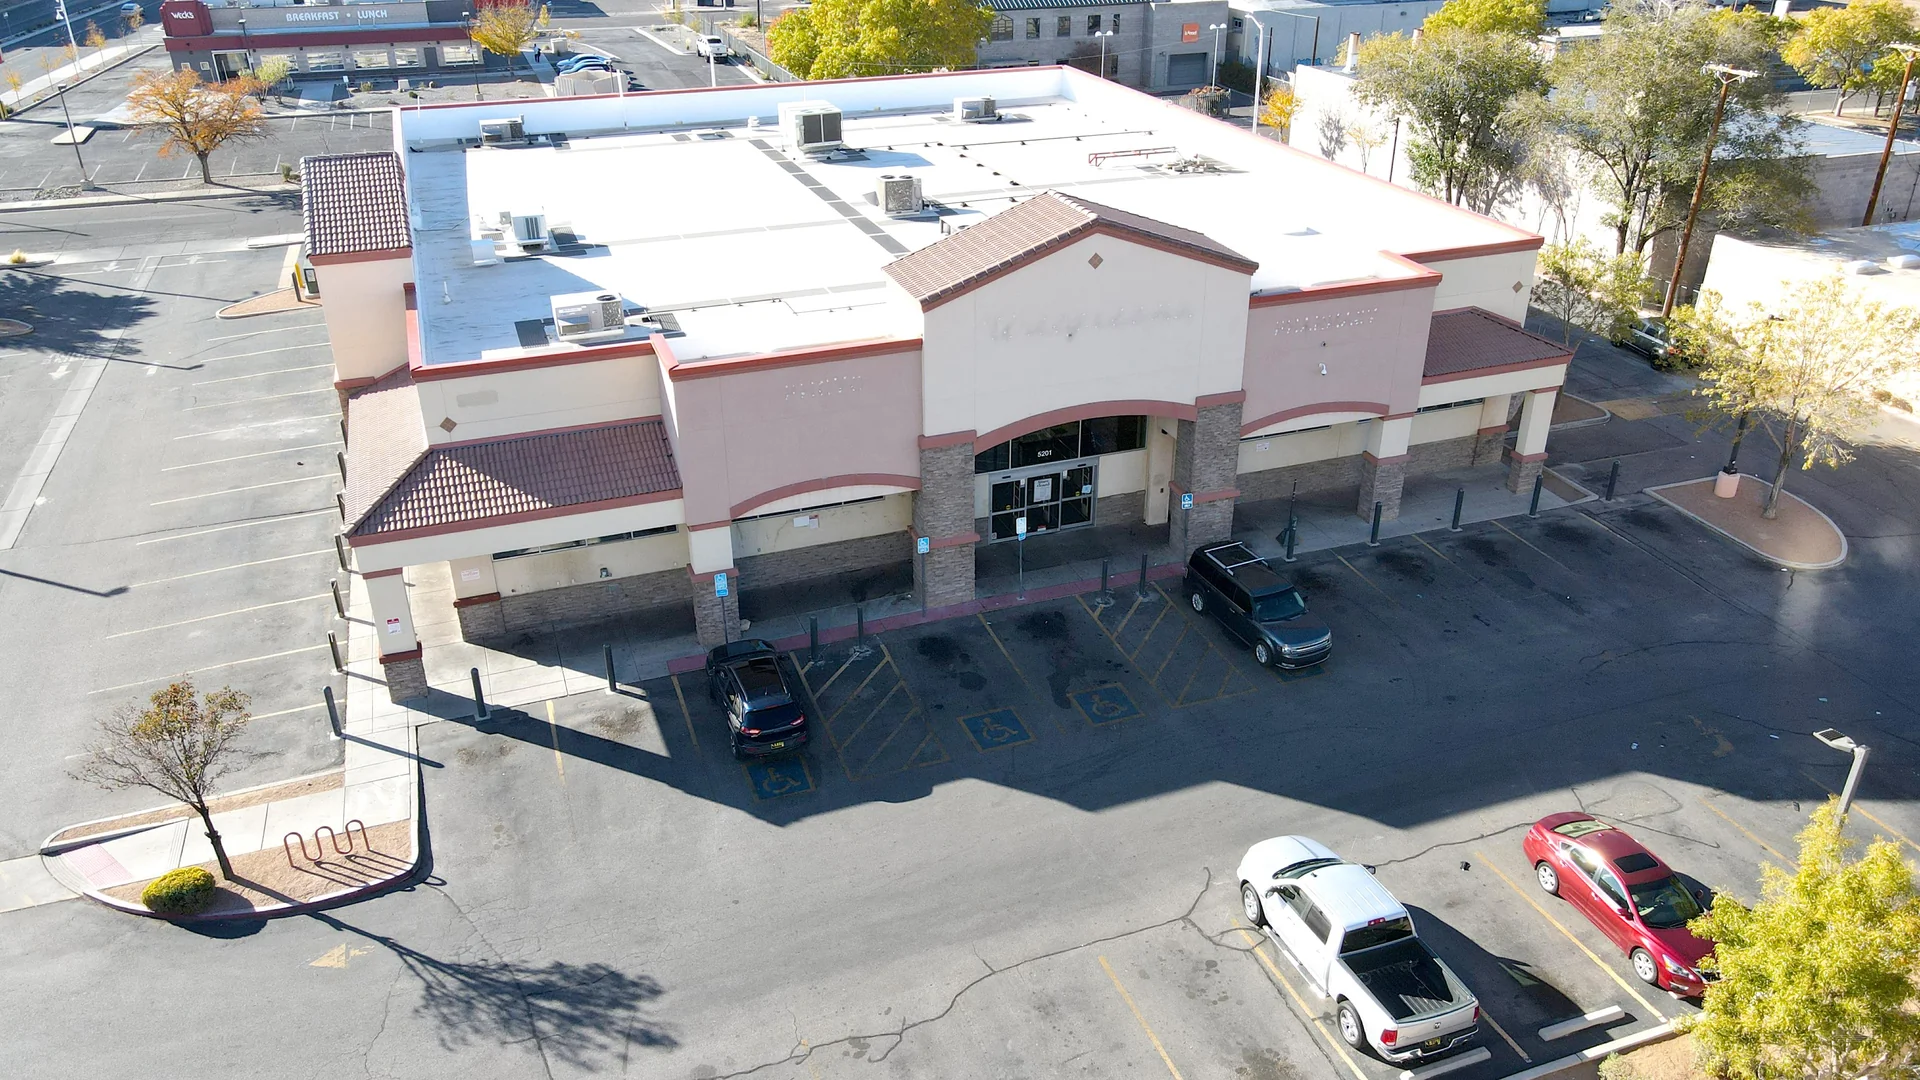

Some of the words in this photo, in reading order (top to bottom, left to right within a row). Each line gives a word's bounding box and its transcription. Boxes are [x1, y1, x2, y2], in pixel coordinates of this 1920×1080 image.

[285, 11, 339, 22] BREAKFAST
[357, 9, 388, 20] LUNCH
[1037, 449, 1053, 458] 5201
